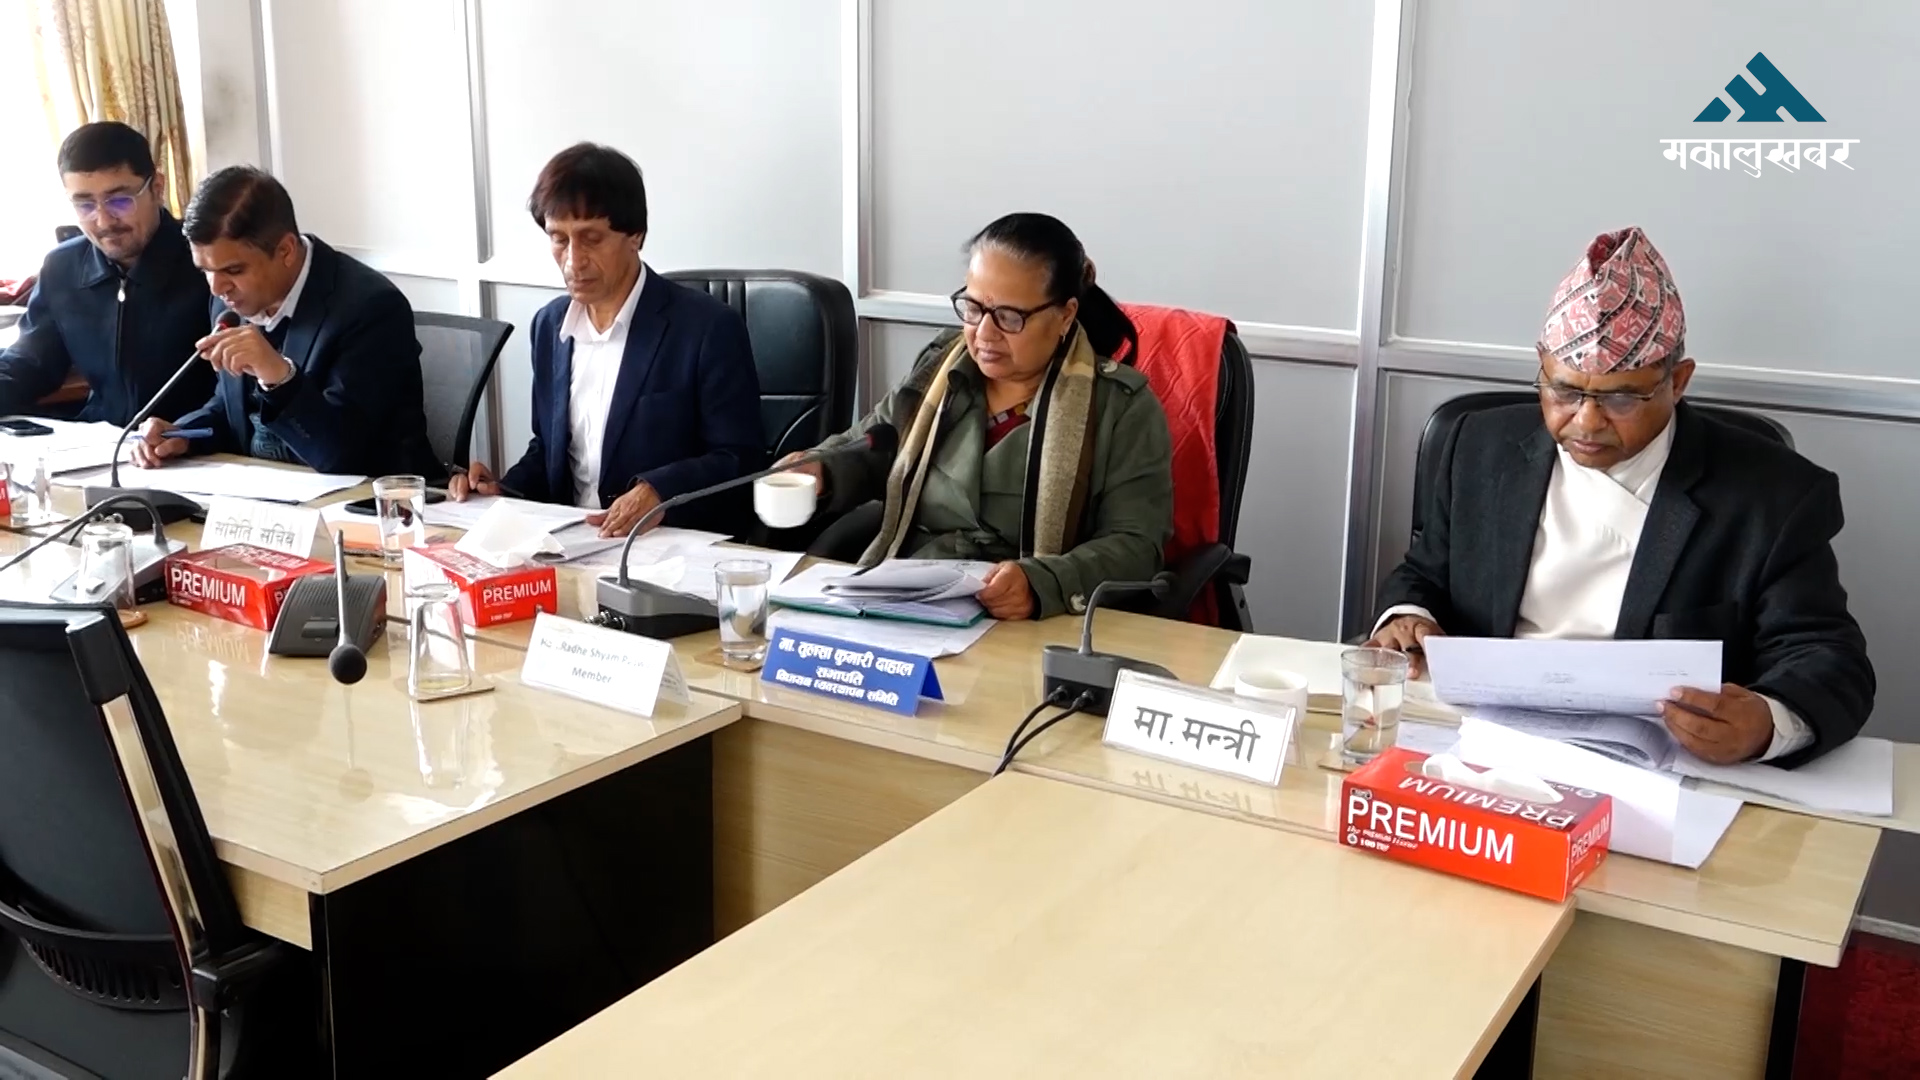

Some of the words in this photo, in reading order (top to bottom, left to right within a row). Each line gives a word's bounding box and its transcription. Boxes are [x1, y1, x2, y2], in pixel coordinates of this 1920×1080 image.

[214, 516, 253, 541] समिति
[171, 567, 246, 607] PREMIUM
[483, 579, 551, 604] PREMIUM
[572, 667, 612, 684] Member
[779, 637, 795, 652] मा.
[834, 648, 874, 668] कुमारी
[876, 656, 914, 676] दाहाल
[816, 665, 864, 686] सभापति
[1134, 706, 1174, 745] मा.
[1182, 717, 1261, 763] मन्त्री
[1399, 776, 1577, 829] PREMIUM
[1348, 795, 1514, 864] PREMIUM
[1571, 812, 1610, 860] PREMIUM
